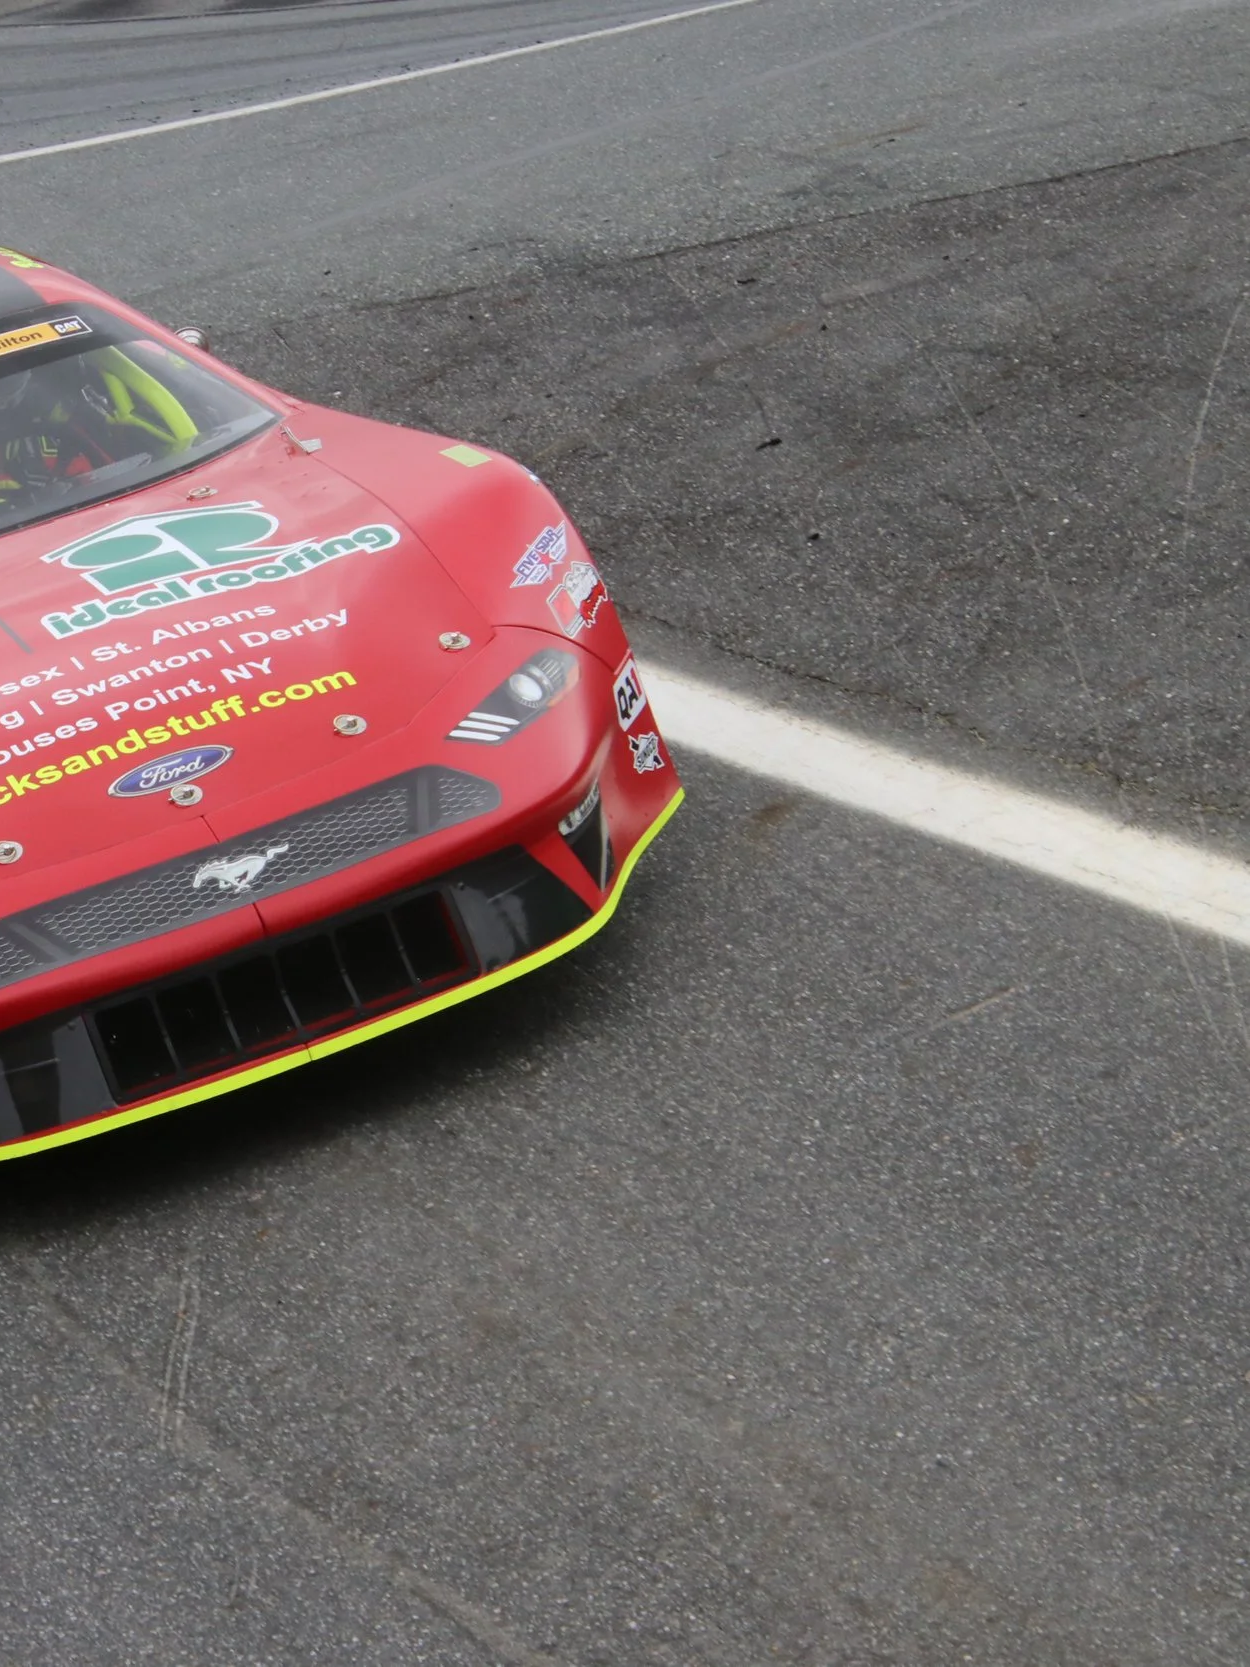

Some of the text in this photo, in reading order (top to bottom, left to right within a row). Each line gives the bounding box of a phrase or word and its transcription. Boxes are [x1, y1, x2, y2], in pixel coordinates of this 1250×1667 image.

[53, 320, 82, 334] CAT
[516, 550, 539, 577] FIVE
[535, 529, 559, 553] STAR
[51, 647, 213, 706] Swanton
[239, 608, 348, 648] Derby
[91, 640, 142, 662] St.
[152, 605, 277, 645] Albans
[104, 678, 216, 721] Point,
[220, 656, 272, 685] NY
[617, 667, 643, 720] QA1
[140, 755, 208, 790] Ford
